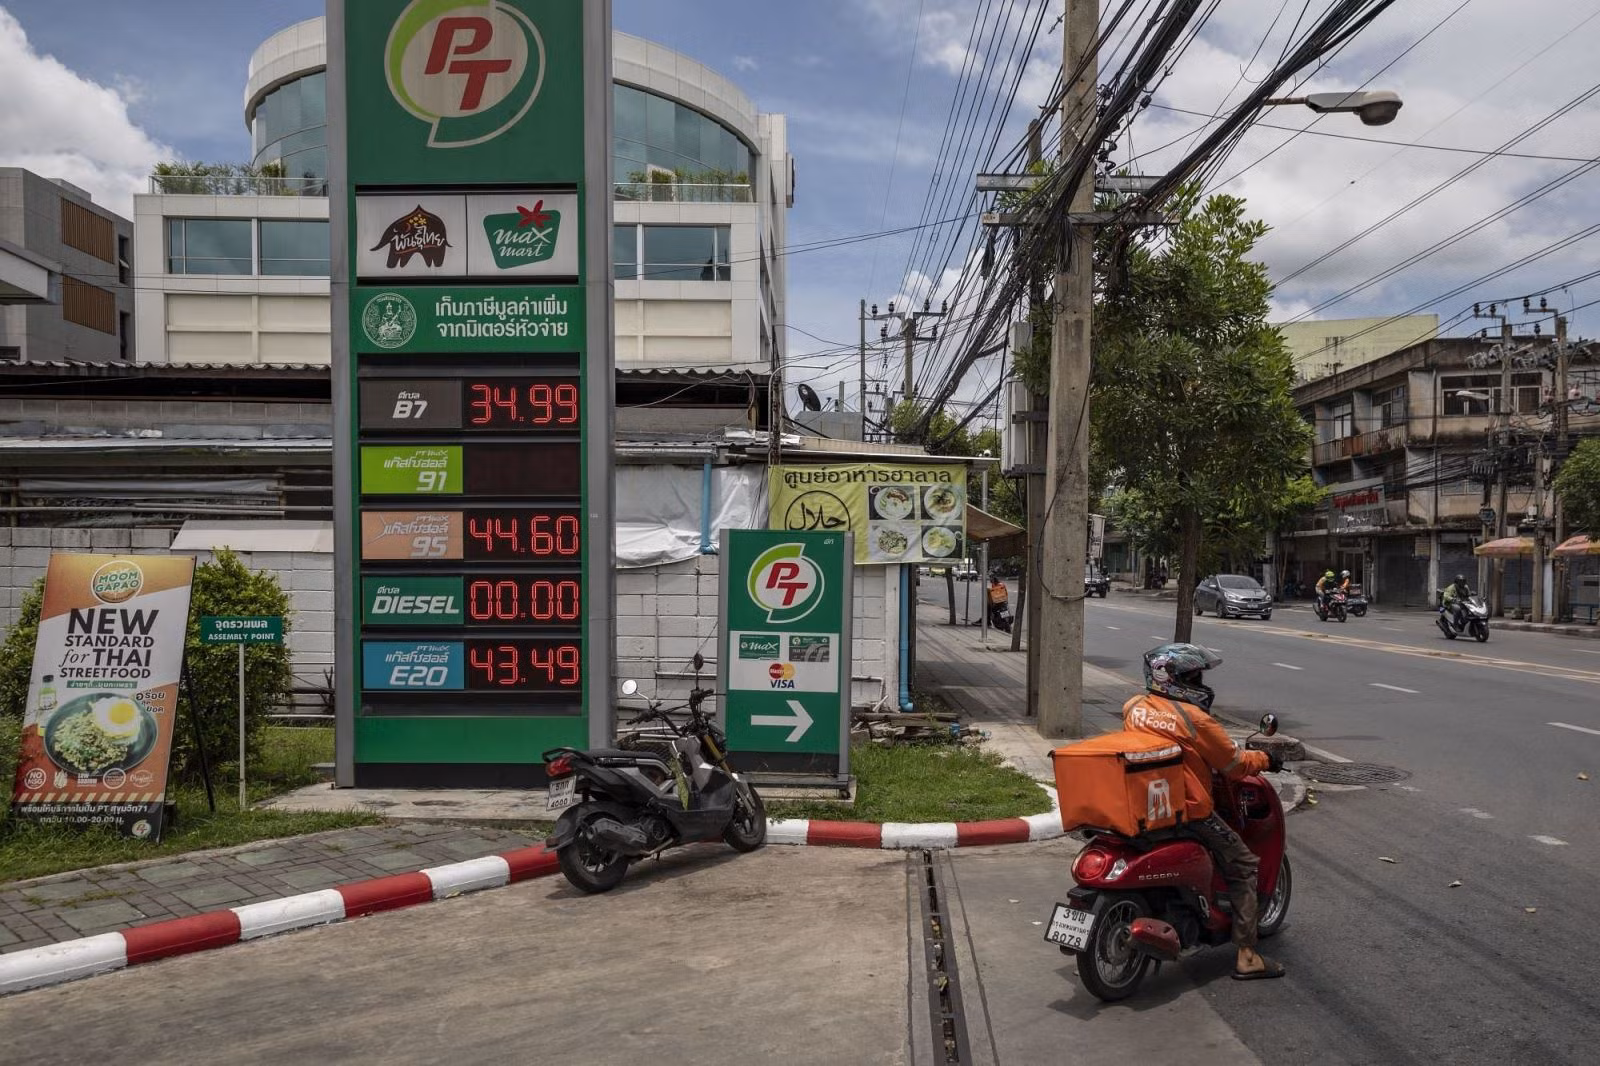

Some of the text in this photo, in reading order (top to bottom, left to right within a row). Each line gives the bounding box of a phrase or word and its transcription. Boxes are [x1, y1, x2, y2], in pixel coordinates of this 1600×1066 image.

[424, 16, 512, 110] PT
[499, 242, 547, 257] mart
[435, 294, 568, 320] เก็บภาษีมูลค่าเพิ่ม
[436, 317, 569, 338] จากมิเตอร์หัวจ่าย
[392, 400, 428, 419] B7
[471, 384, 577, 423] 34.99
[416, 471, 448, 491] 91
[784, 467, 952, 488] ศูนย์อาหารฮาลาล
[470, 516, 579, 555] 44.60
[411, 536, 448, 557] 95
[95, 579, 140, 593] GAPAO
[99, 571, 138, 584] MOOM
[765, 562, 809, 606] PT
[371, 595, 460, 614] DIESEL
[470, 581, 579, 619] 00.00
[67, 608, 160, 635] NEW
[215, 620, 268, 631] จุดรวมพล
[64, 635, 155, 648] STANDARD
[58, 648, 152, 667] for THAI
[470, 646, 579, 685] 43.49
[389, 665, 448, 686] E20
[770, 679, 795, 689] VISA
[1146, 716, 1177, 732] Food
[1051, 930, 1082, 947] 8078
